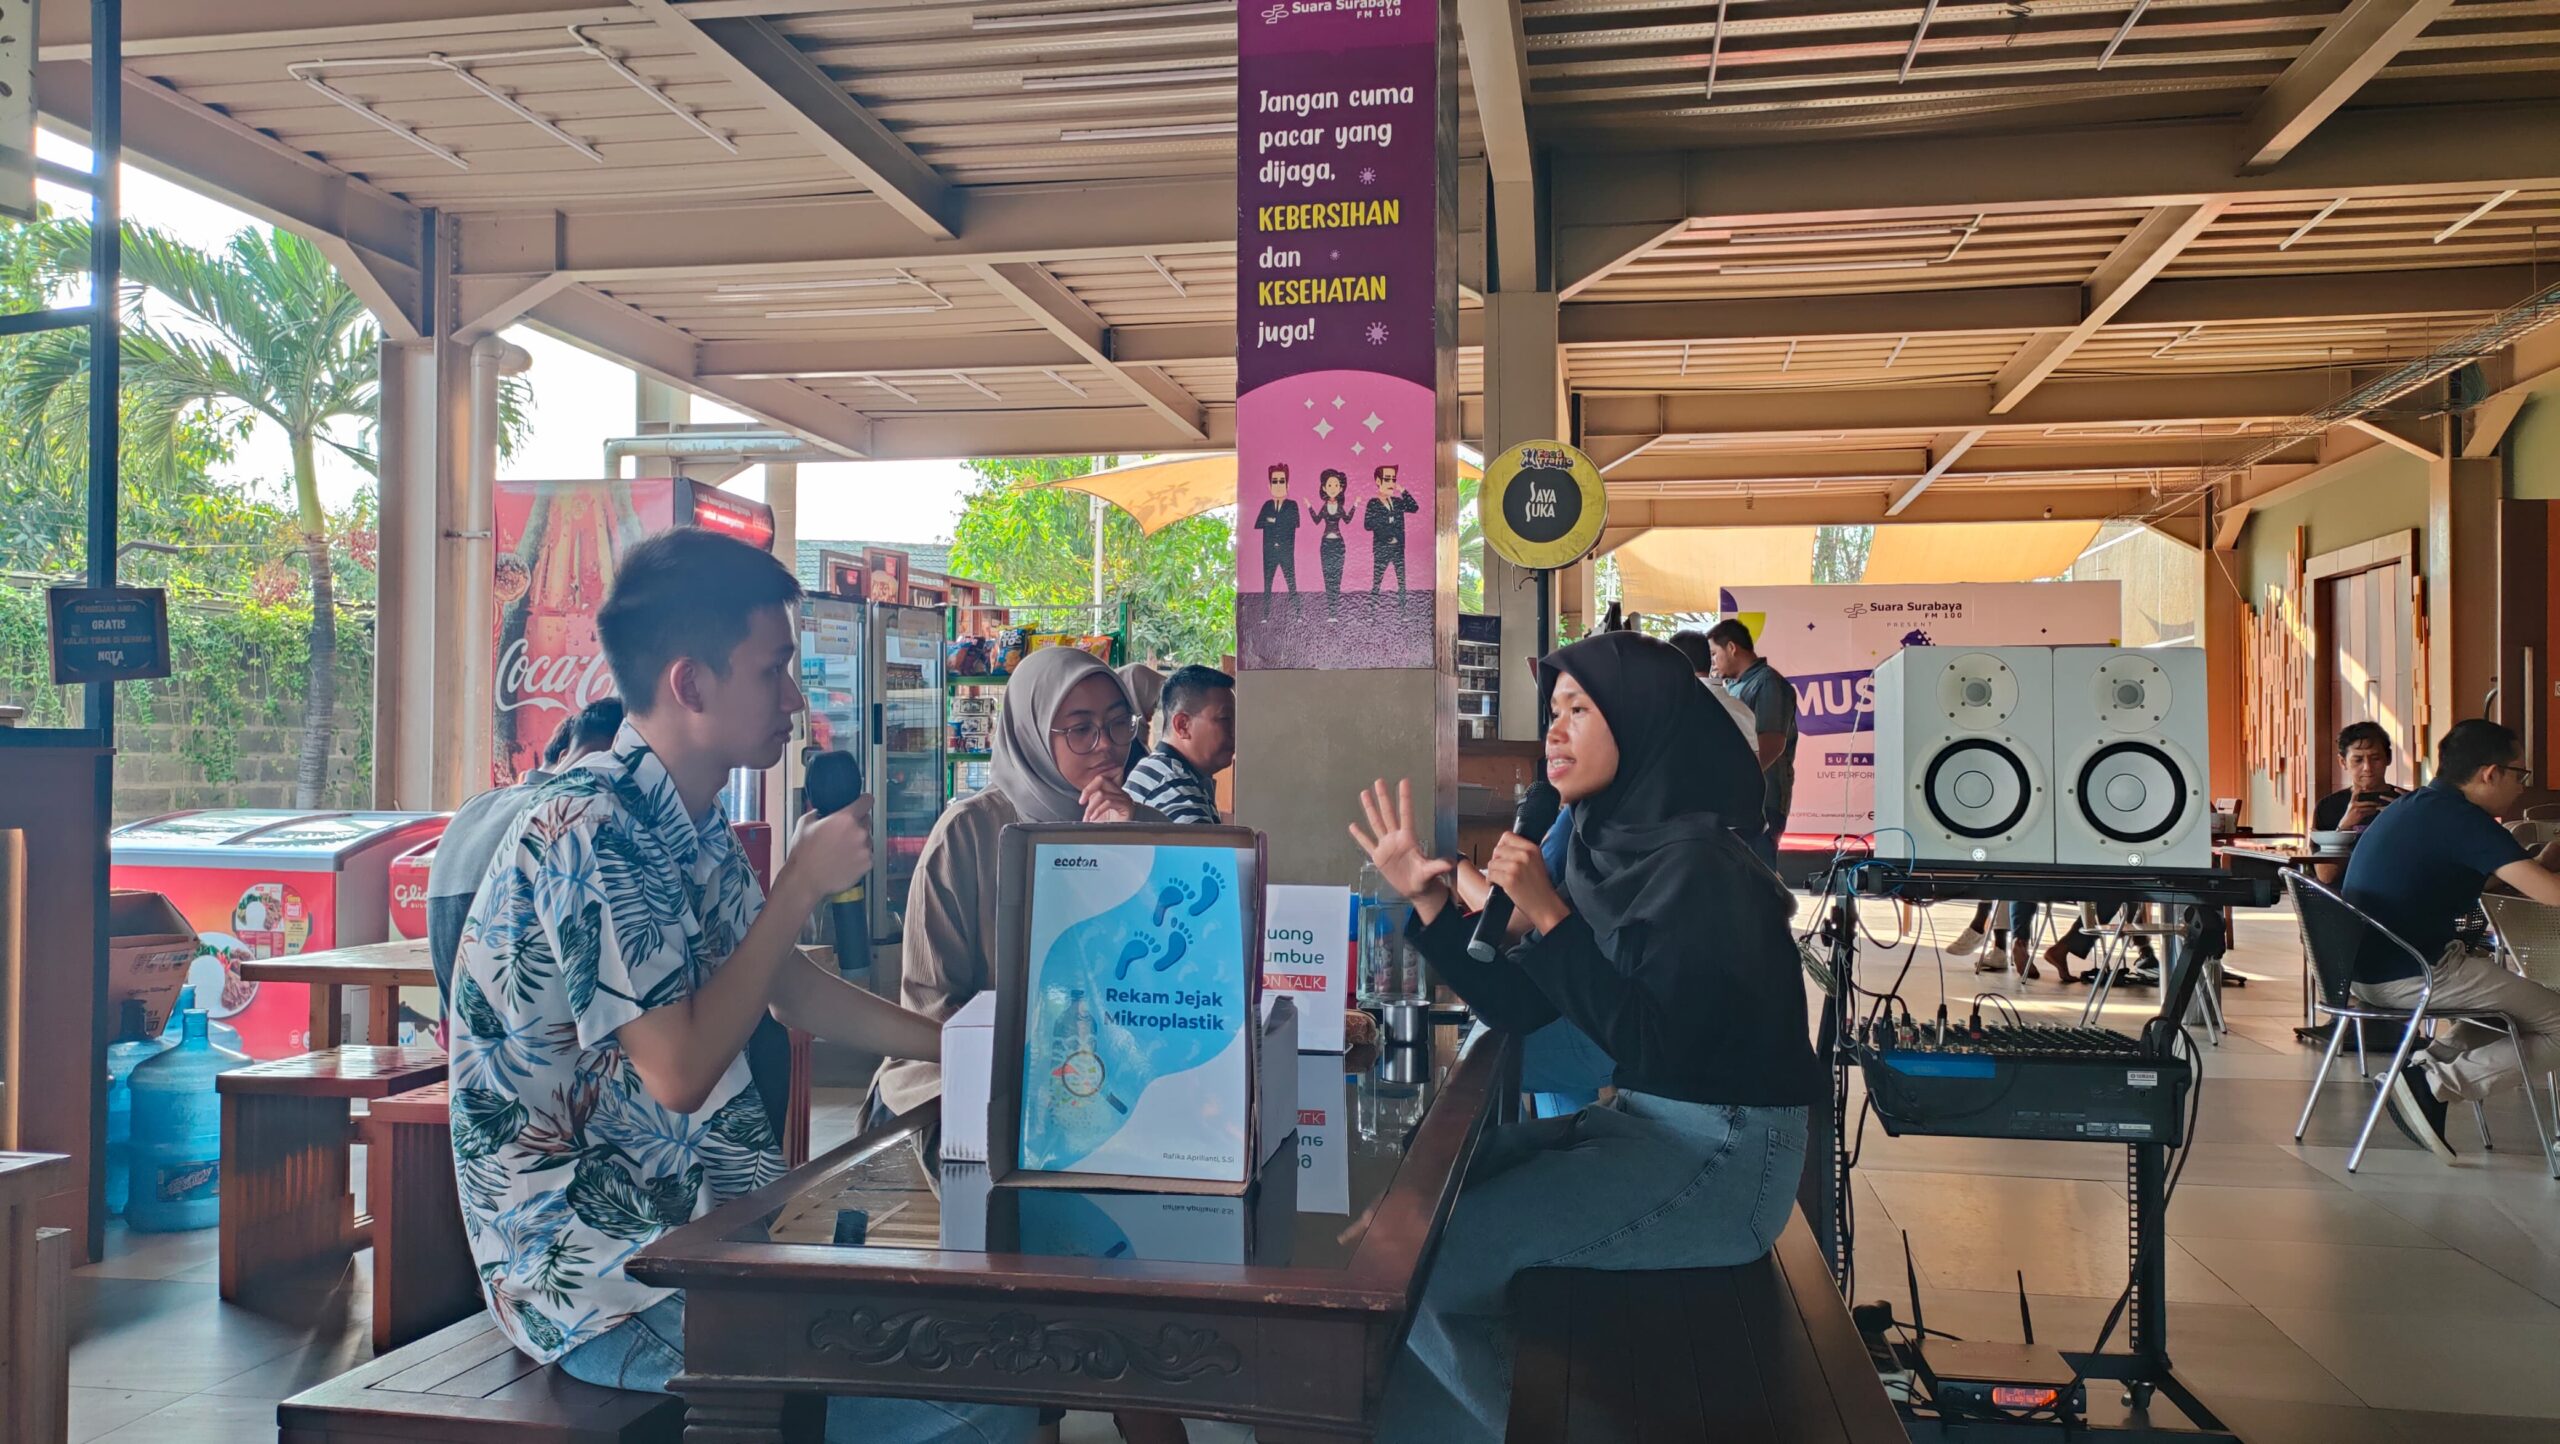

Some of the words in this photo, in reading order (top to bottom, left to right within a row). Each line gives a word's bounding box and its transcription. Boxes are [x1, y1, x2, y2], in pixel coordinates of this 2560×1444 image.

[1292, 1, 1332, 13] Suara
[1336, 0, 1401, 10] Surabaya
[1356, 11, 1372, 19] FM
[1379, 8, 1401, 17] 100
[1259, 90, 1339, 117] Jangan
[1349, 86, 1414, 107] cuma
[1259, 127, 1325, 154] pacar
[1335, 122, 1392, 149] yang
[1259, 160, 1336, 188] dijaga,
[1258, 199, 1400, 232] KEBERSIHAN
[1259, 246, 1301, 268] dan
[1258, 275, 1387, 306] KESEHATAN
[1257, 318, 1315, 348] juga!
[1530, 481, 1557, 503] SAYA
[1525, 501, 1555, 522] SUKA
[1870, 602, 1903, 612] Suara
[1907, 601, 1962, 612] Surabaya
[91, 619, 126, 630] GRATIS
[97, 650, 124, 662] NOTA
[495, 638, 618, 713] Coca-C
[1817, 771, 1836, 779] LIVE
[1054, 856, 1099, 867] ecoton
[394, 884, 428, 908] Glic
[1265, 929, 1313, 945] uang
[1286, 975, 1325, 989] TALK
[1106, 988, 1170, 1004] Rekam
[1174, 990, 1223, 1009] Jejak
[1104, 1009, 1224, 1031] Mikroplastik
